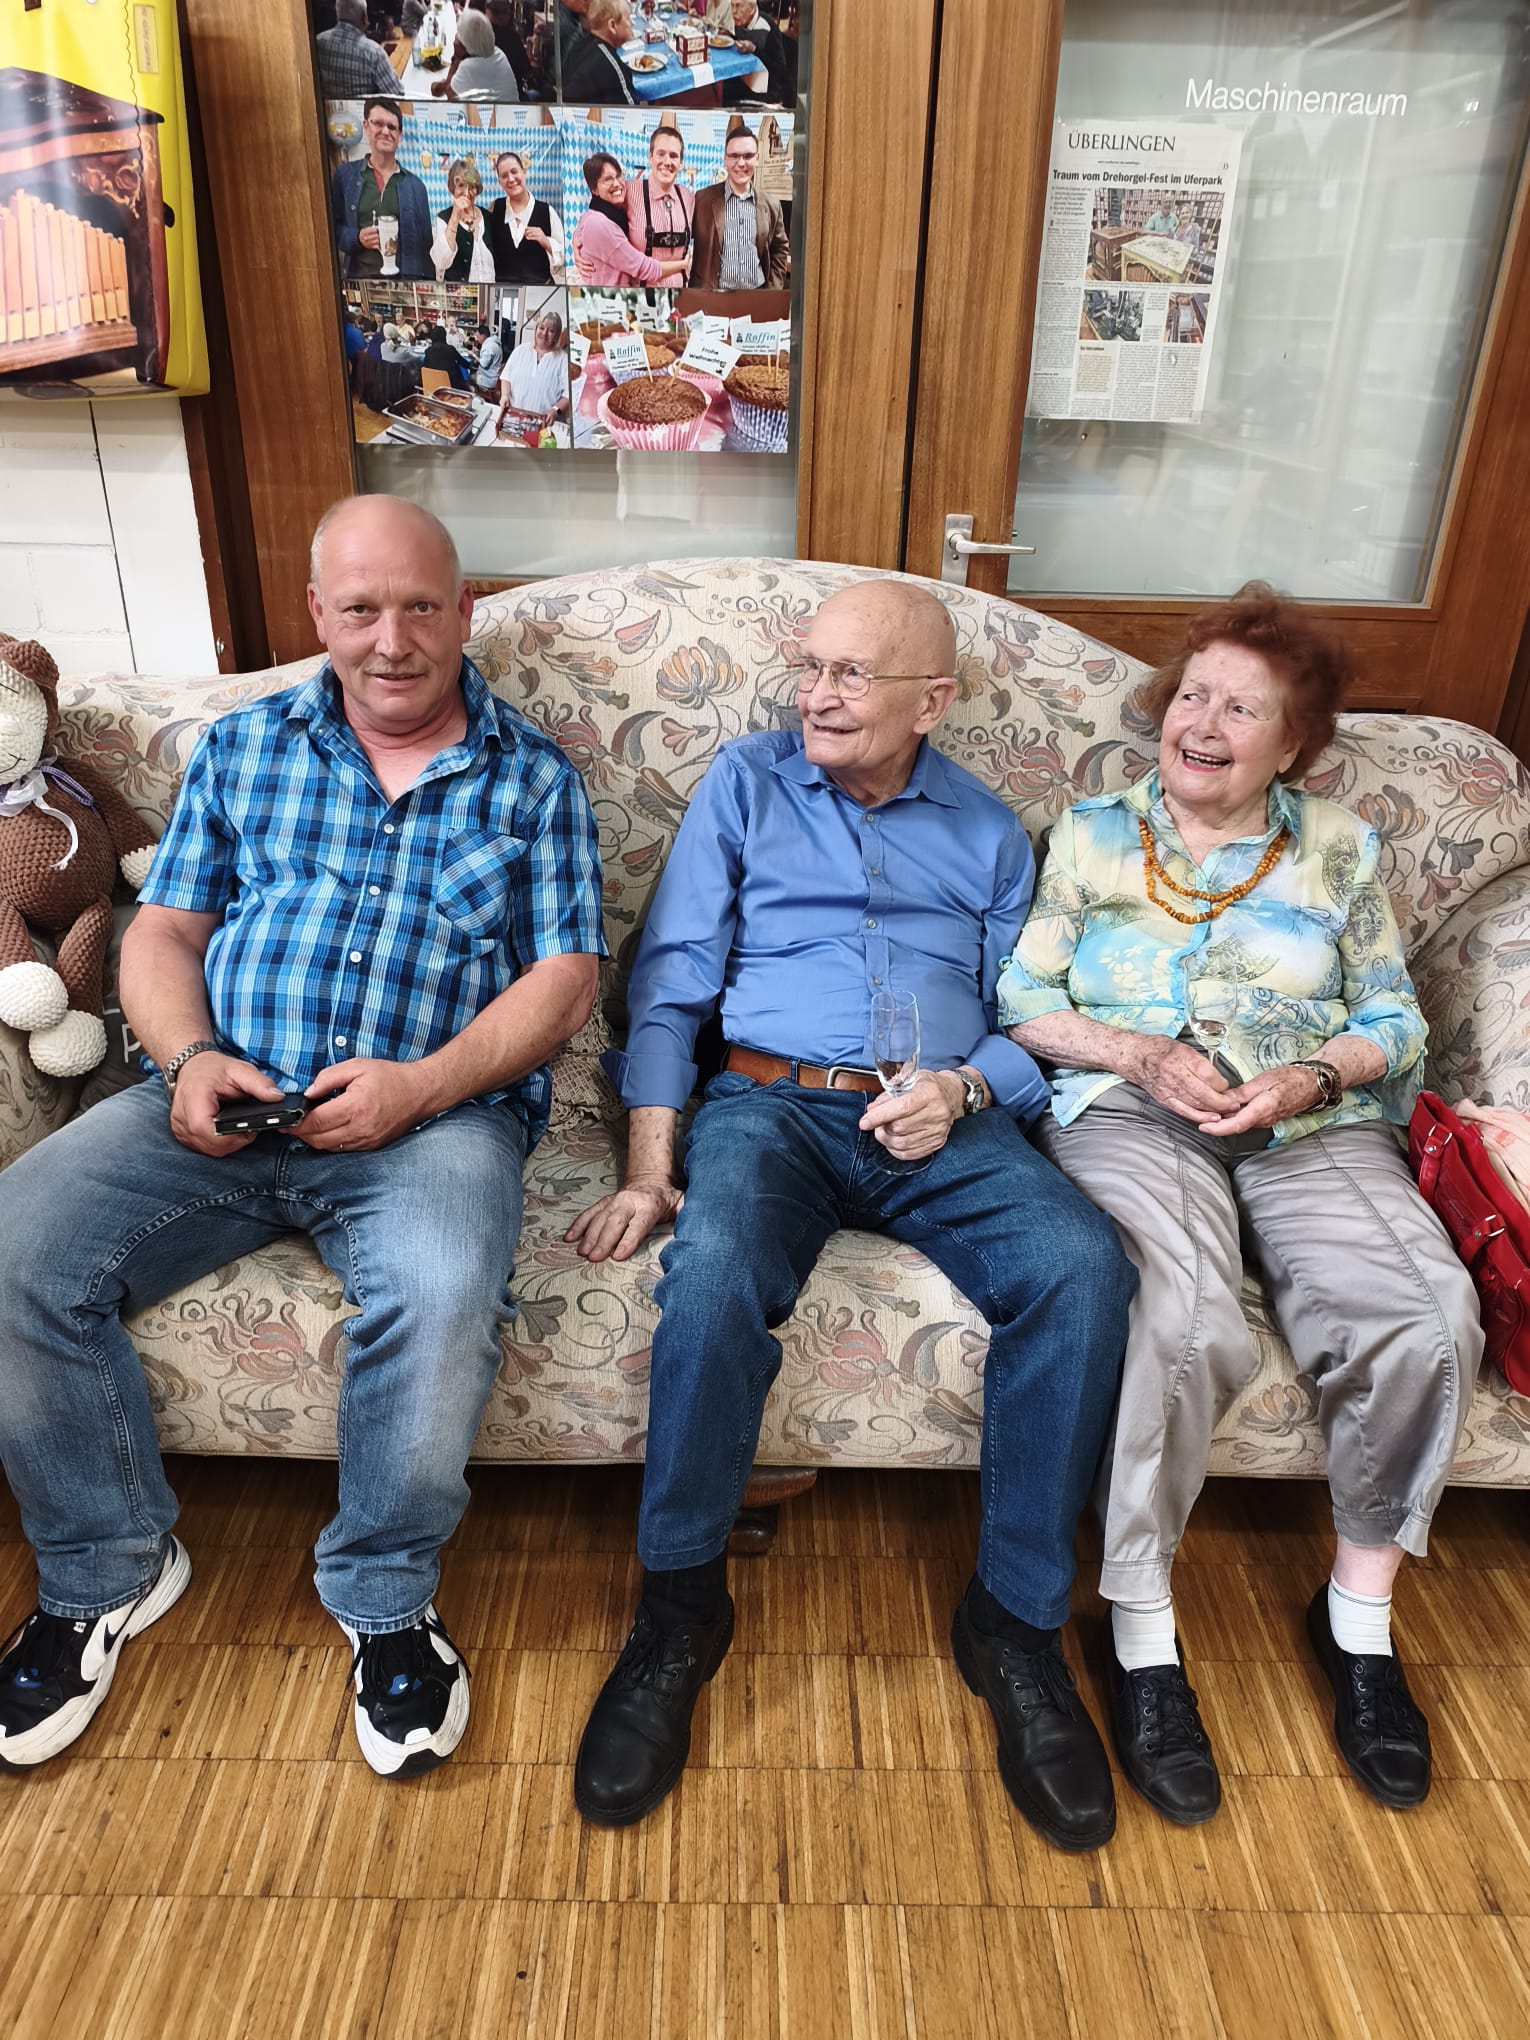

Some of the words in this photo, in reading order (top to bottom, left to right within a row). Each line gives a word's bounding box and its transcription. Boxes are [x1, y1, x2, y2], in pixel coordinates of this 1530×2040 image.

[1185, 78, 1408, 116] Maschinenraum
[1068, 129, 1176, 152] ÜBERLINGEN
[1053, 169, 1079, 181] Traum
[1082, 173, 1100, 181] vom
[1103, 171, 1168, 185] Drehorgel-Fest
[1170, 174, 1182, 184] im
[1184, 175, 1223, 187] Uferpark
[744, 331, 776, 344] Raffin
[616, 344, 641, 359] Raffin
